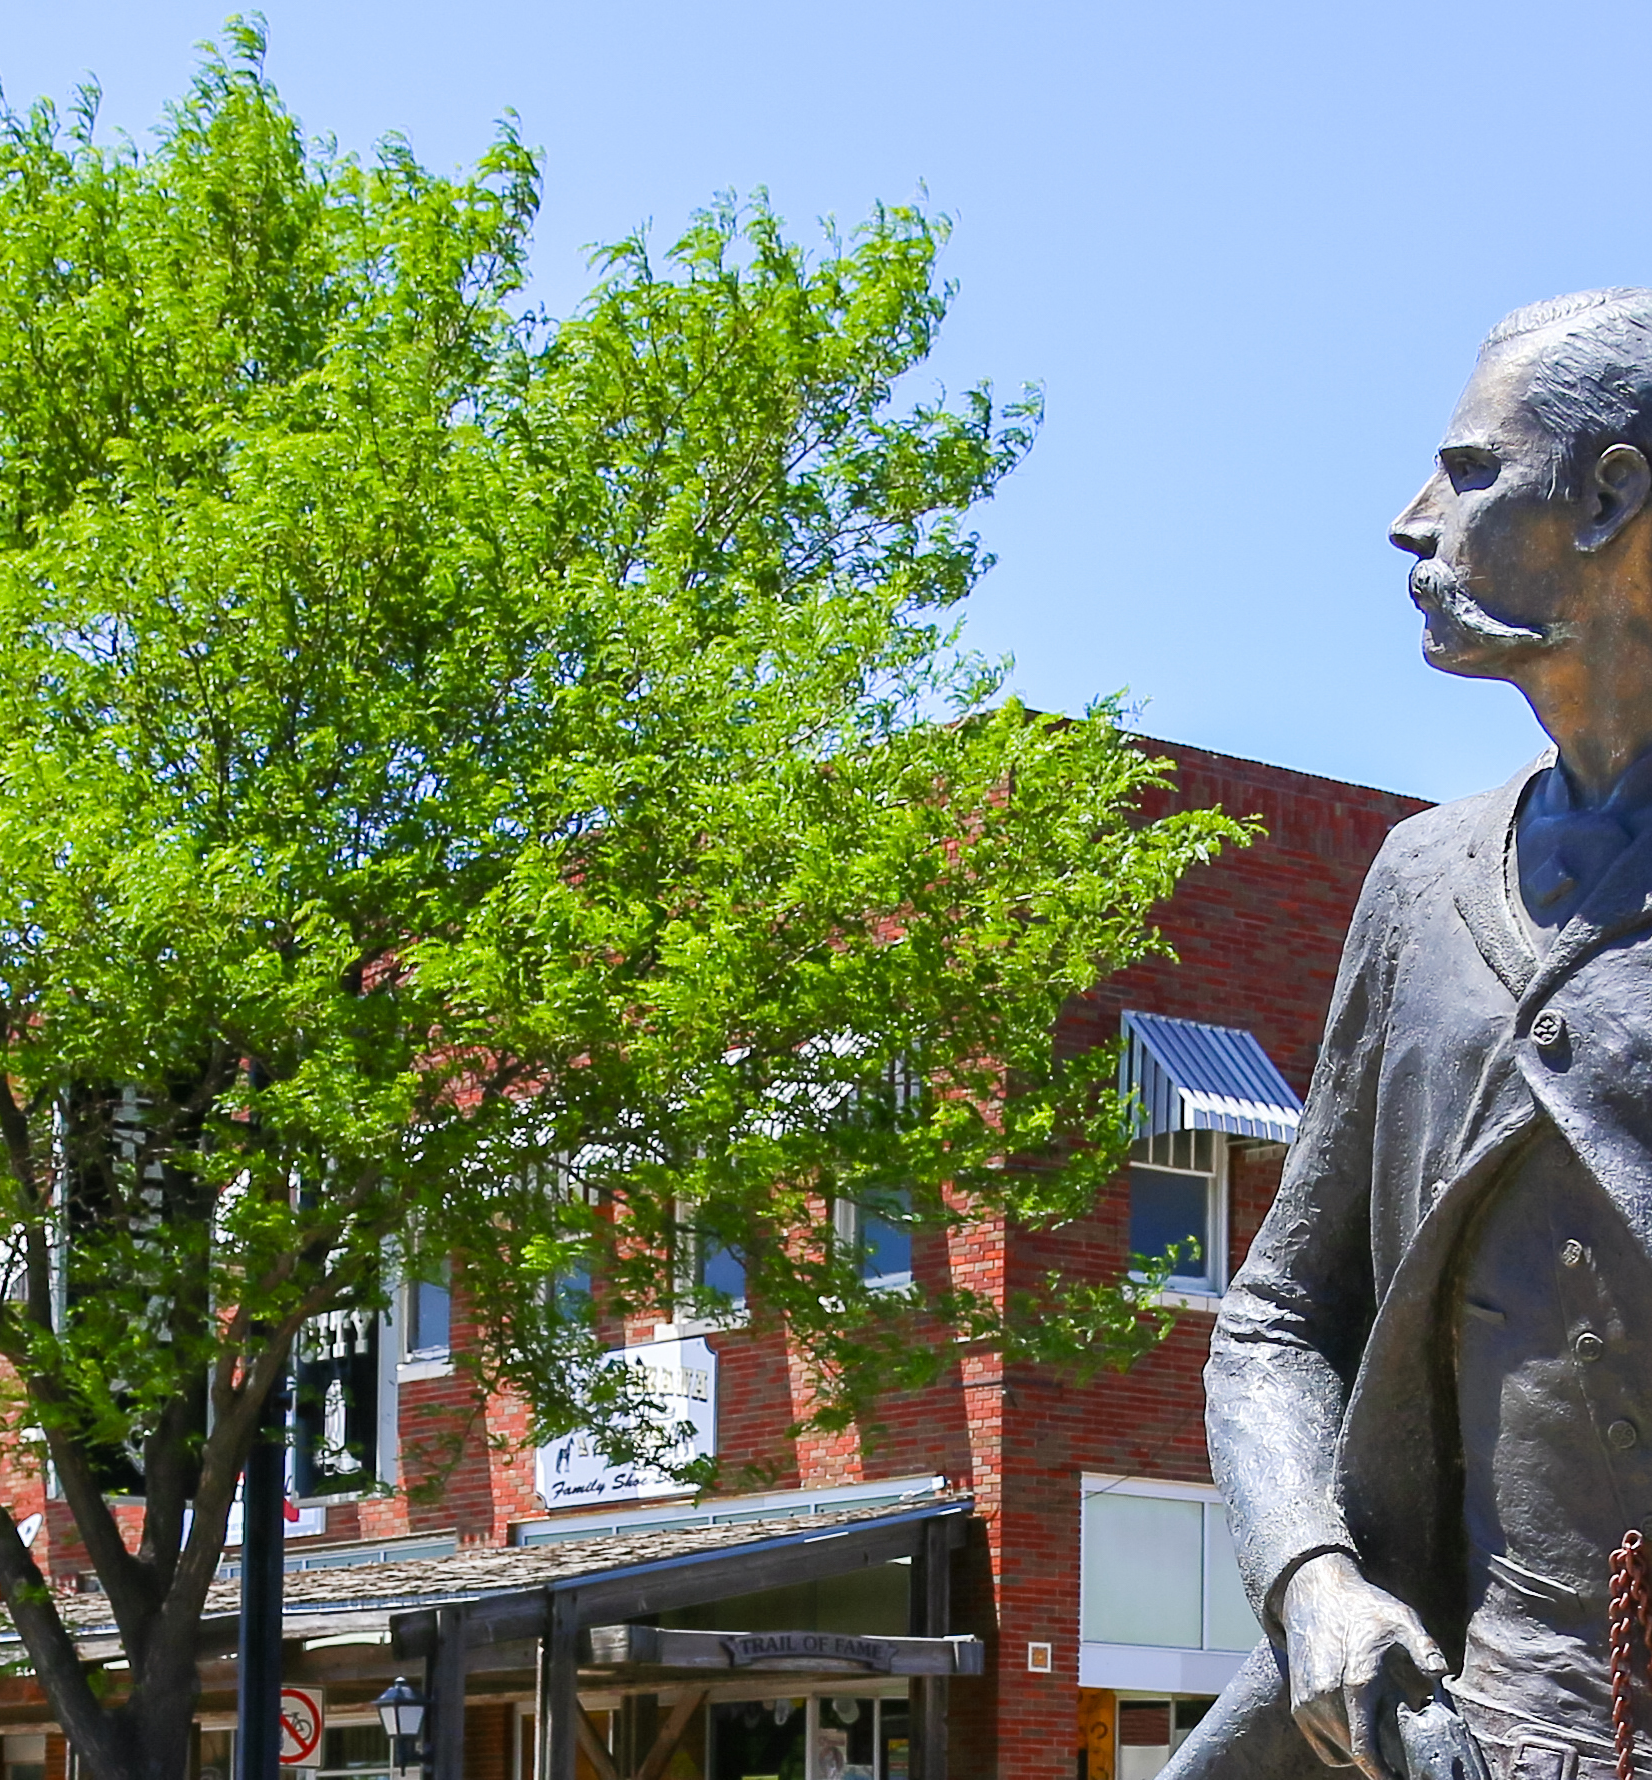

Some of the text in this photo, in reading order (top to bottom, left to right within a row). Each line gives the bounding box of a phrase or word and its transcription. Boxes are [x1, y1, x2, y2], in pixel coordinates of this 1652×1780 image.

[552, 1478, 605, 1500] Family
[612, 1473, 647, 1490] Shoe
[742, 1635, 884, 1659] TRAIL OF FAME
